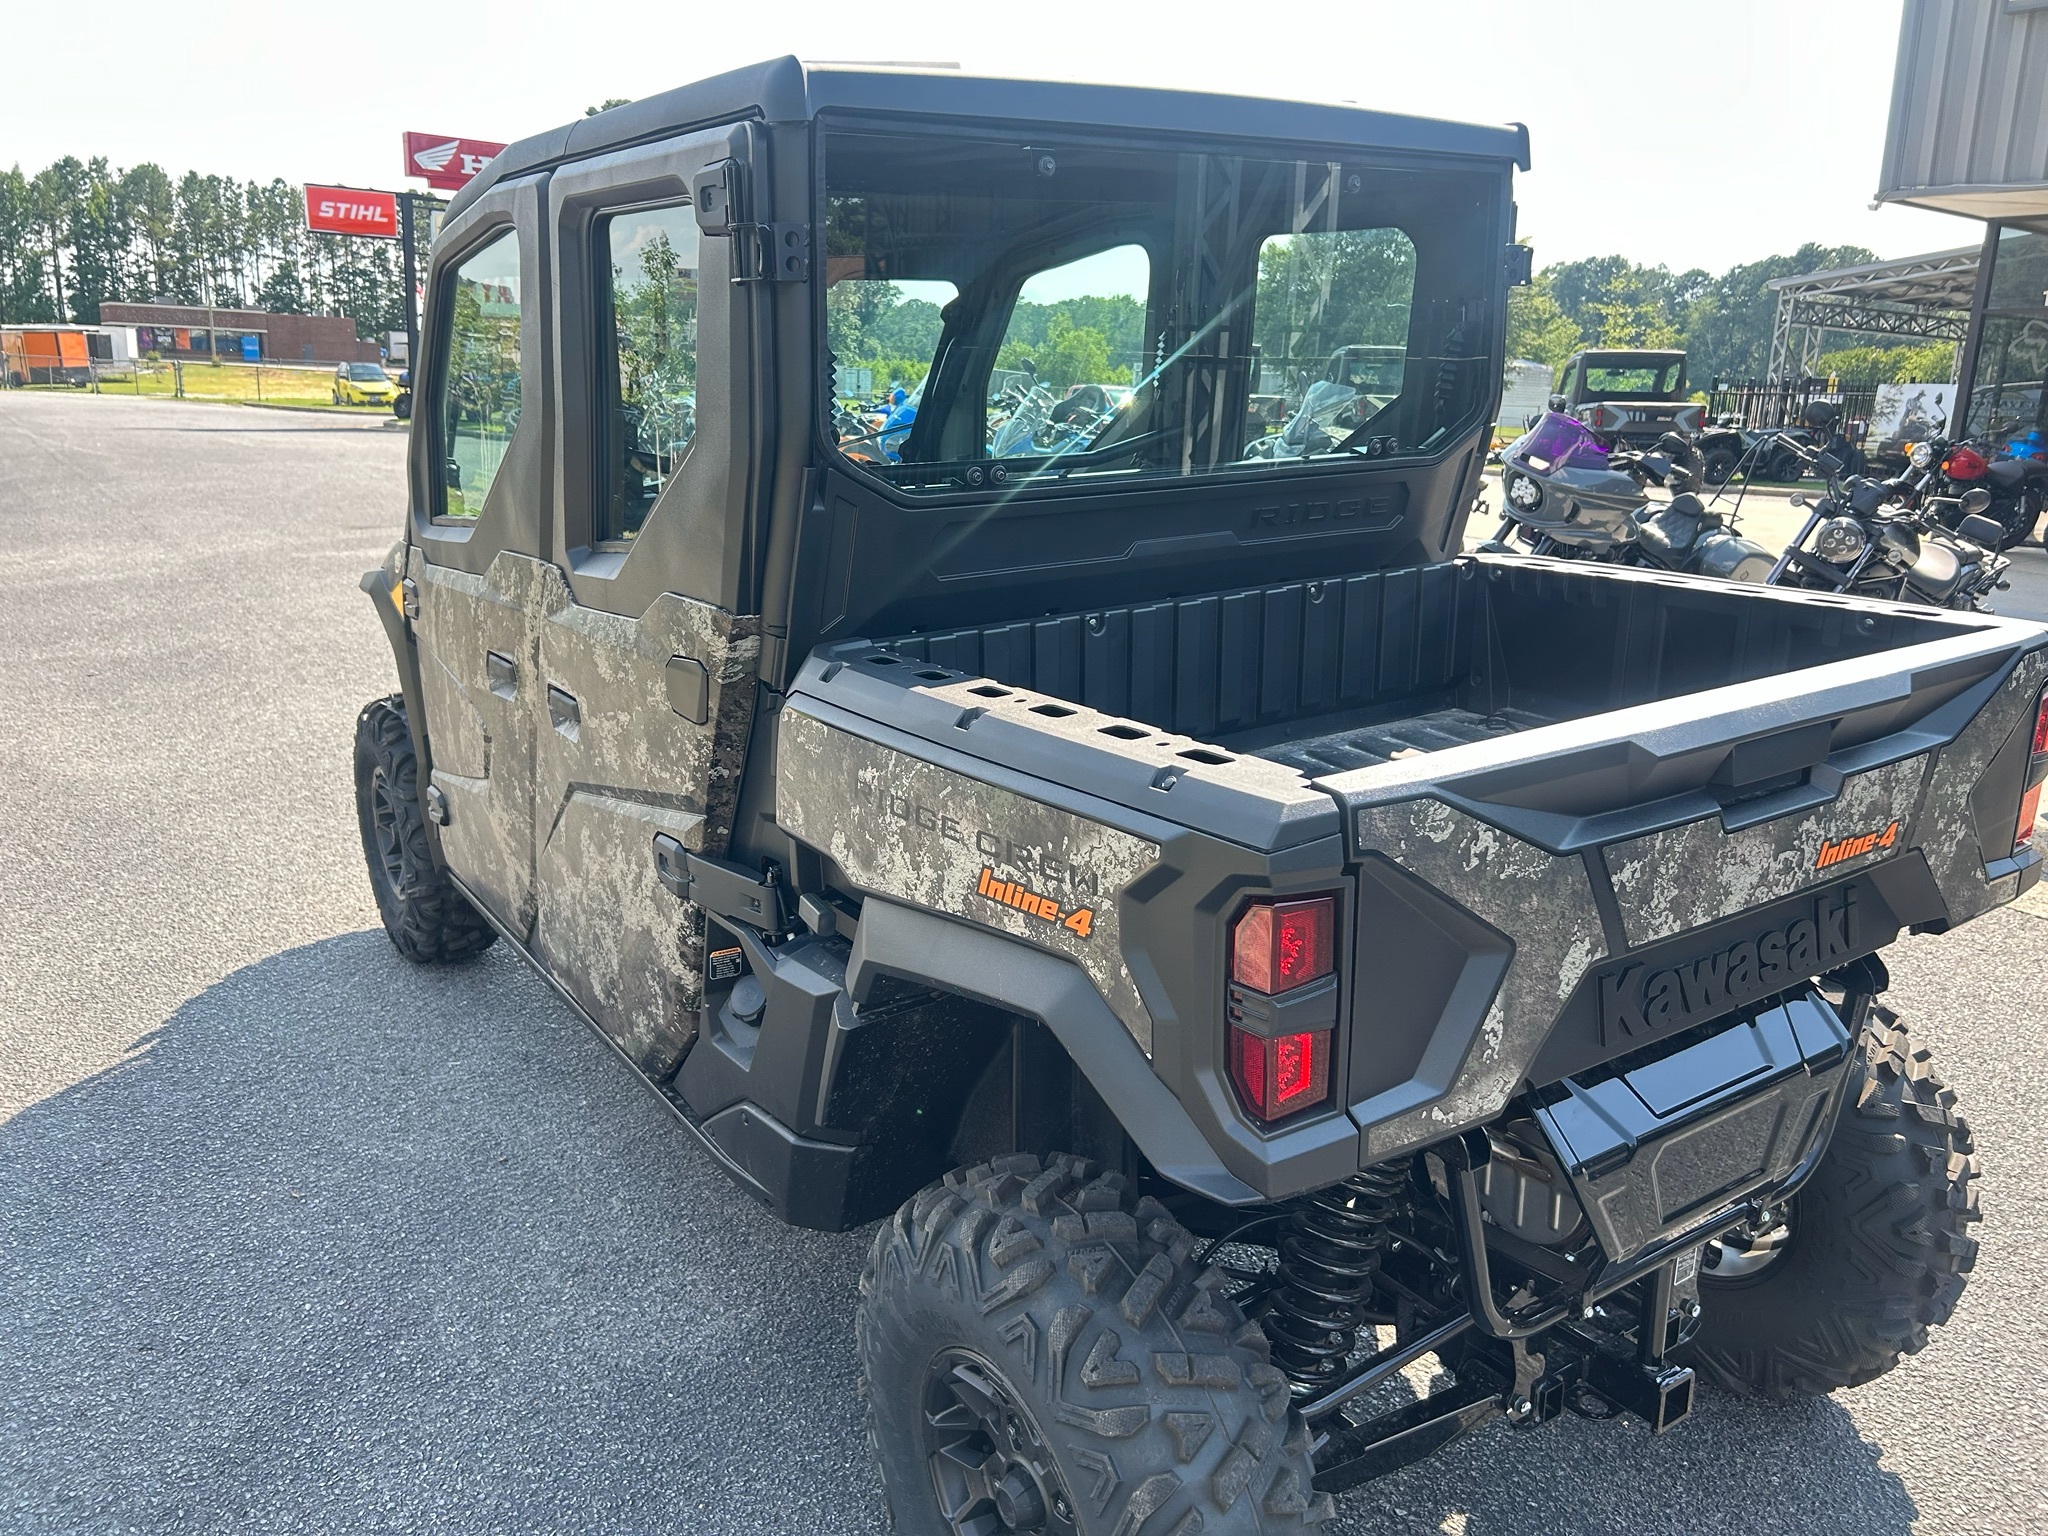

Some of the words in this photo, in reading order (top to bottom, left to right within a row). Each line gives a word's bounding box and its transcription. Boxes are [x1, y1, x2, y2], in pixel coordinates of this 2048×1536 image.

[318, 201, 389, 222] STIHL
[1250, 496, 1391, 529] RIDGE
[852, 779, 965, 842] RIDGE
[976, 831, 1100, 896] CREW
[1817, 822, 1899, 869] Inline-4
[978, 868, 1094, 938] Inline-4
[1597, 885, 1863, 1048] Kawasaki
